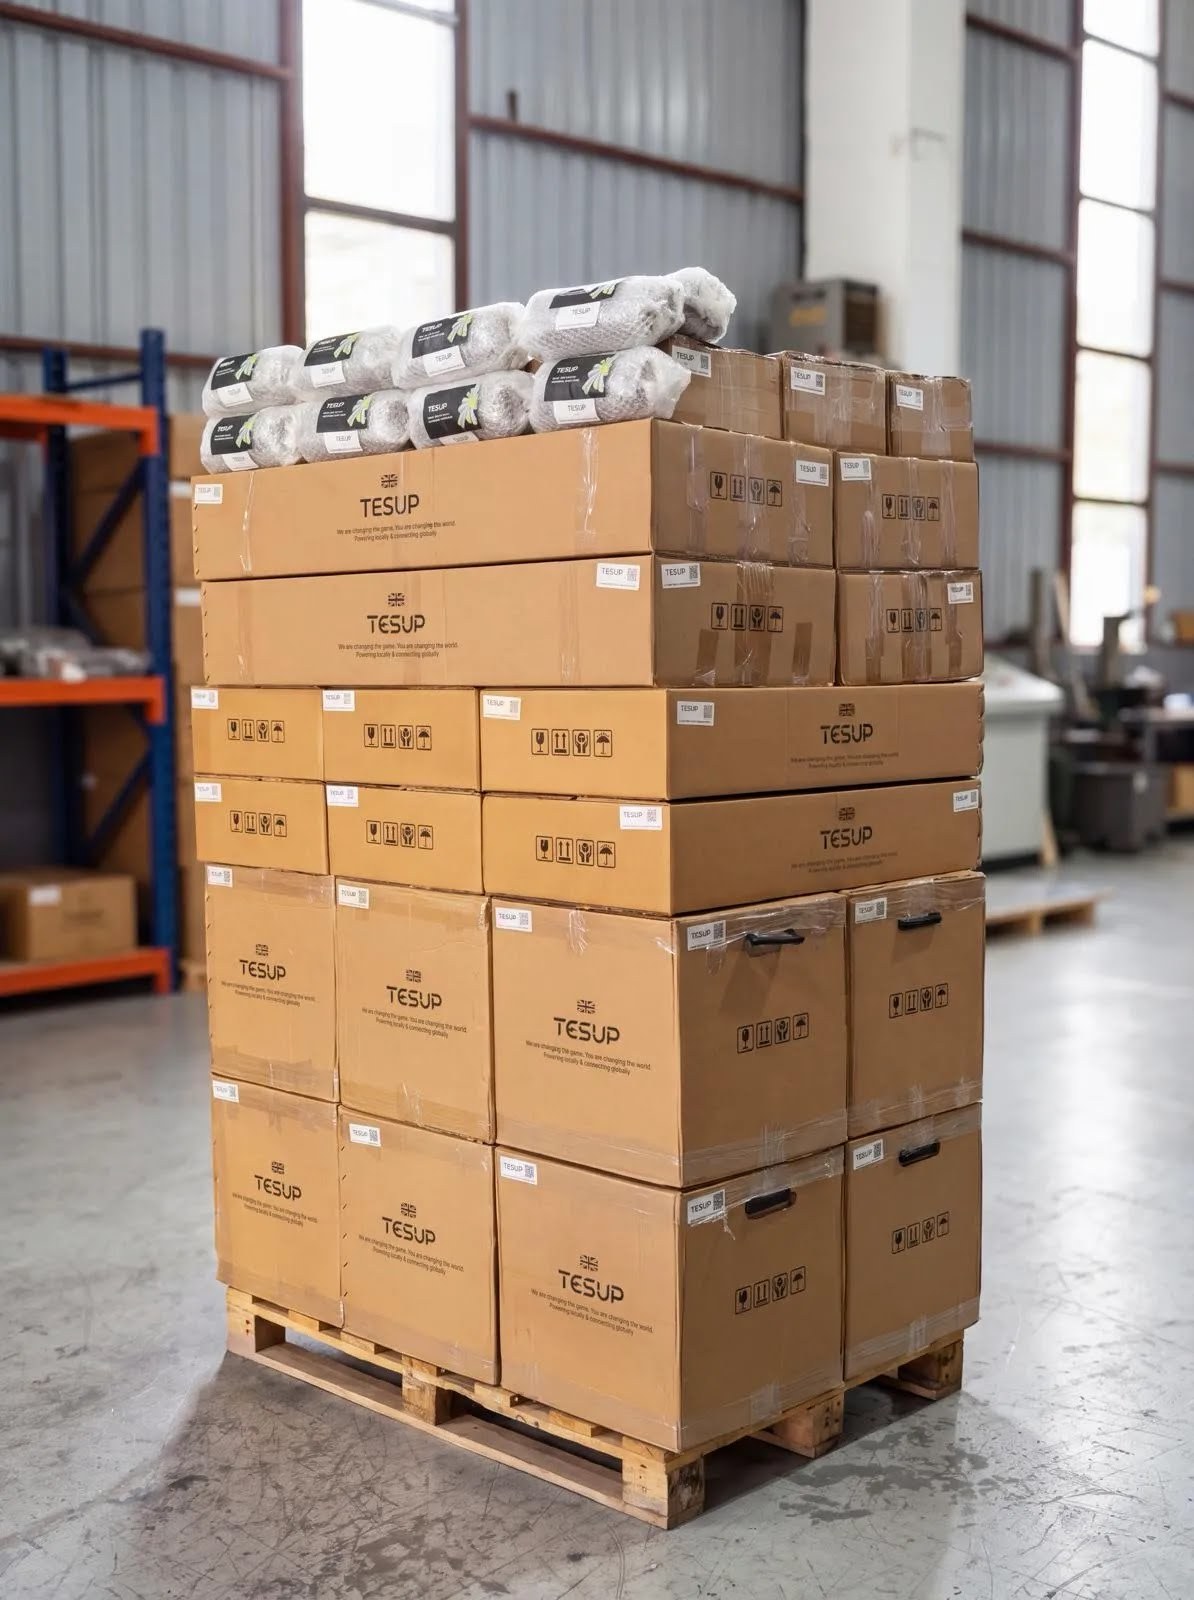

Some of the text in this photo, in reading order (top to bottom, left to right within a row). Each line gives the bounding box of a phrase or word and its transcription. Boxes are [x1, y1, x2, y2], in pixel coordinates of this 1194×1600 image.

[677, 352, 694, 360] TESUP
[794, 371, 810, 379] TESUP
[360, 494, 419, 517] TESUP
[367, 615, 425, 633] TESUP
[820, 724, 873, 744] TESUP
[821, 826, 872, 849] TESUP
[691, 929, 710, 939] TESUP
[240, 959, 286, 980] TESUP
[386, 986, 442, 1009] TESUP
[554, 1017, 620, 1044] TESUP
[504, 1163, 522, 1171] TESUP
[254, 1175, 301, 1200] TESUP
[691, 1201, 711, 1212] TESUP
[382, 1217, 435, 1245] TESUP
[559, 1269, 624, 1303] TESUP
